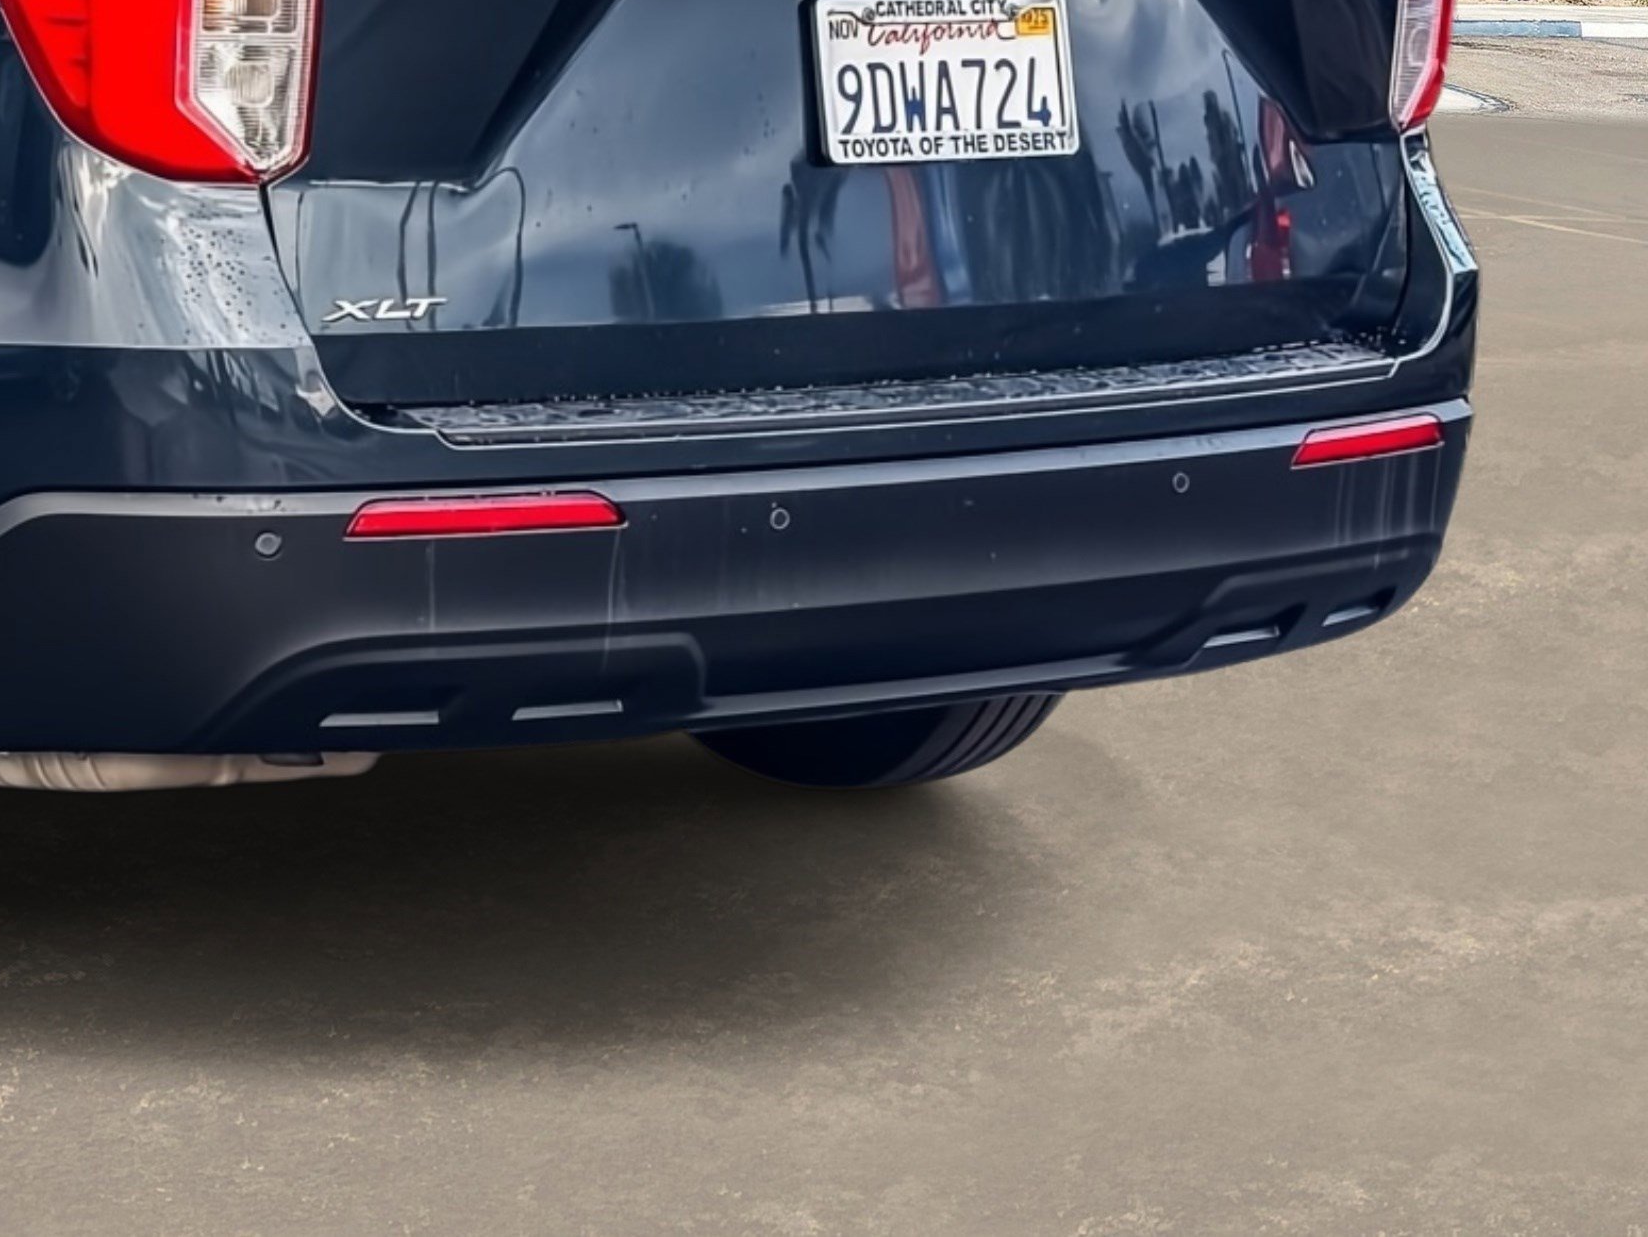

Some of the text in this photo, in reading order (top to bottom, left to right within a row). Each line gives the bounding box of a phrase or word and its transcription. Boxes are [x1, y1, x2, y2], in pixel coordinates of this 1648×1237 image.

[875, 0, 963, 17] CATHEDRAL
[828, 19, 859, 41] NOV
[868, 19, 1015, 55] California
[837, 57, 1052, 135] 9DWA724
[838, 132, 1067, 158] TOYOTA OF THE DESERT
[321, 298, 448, 322] XLT
